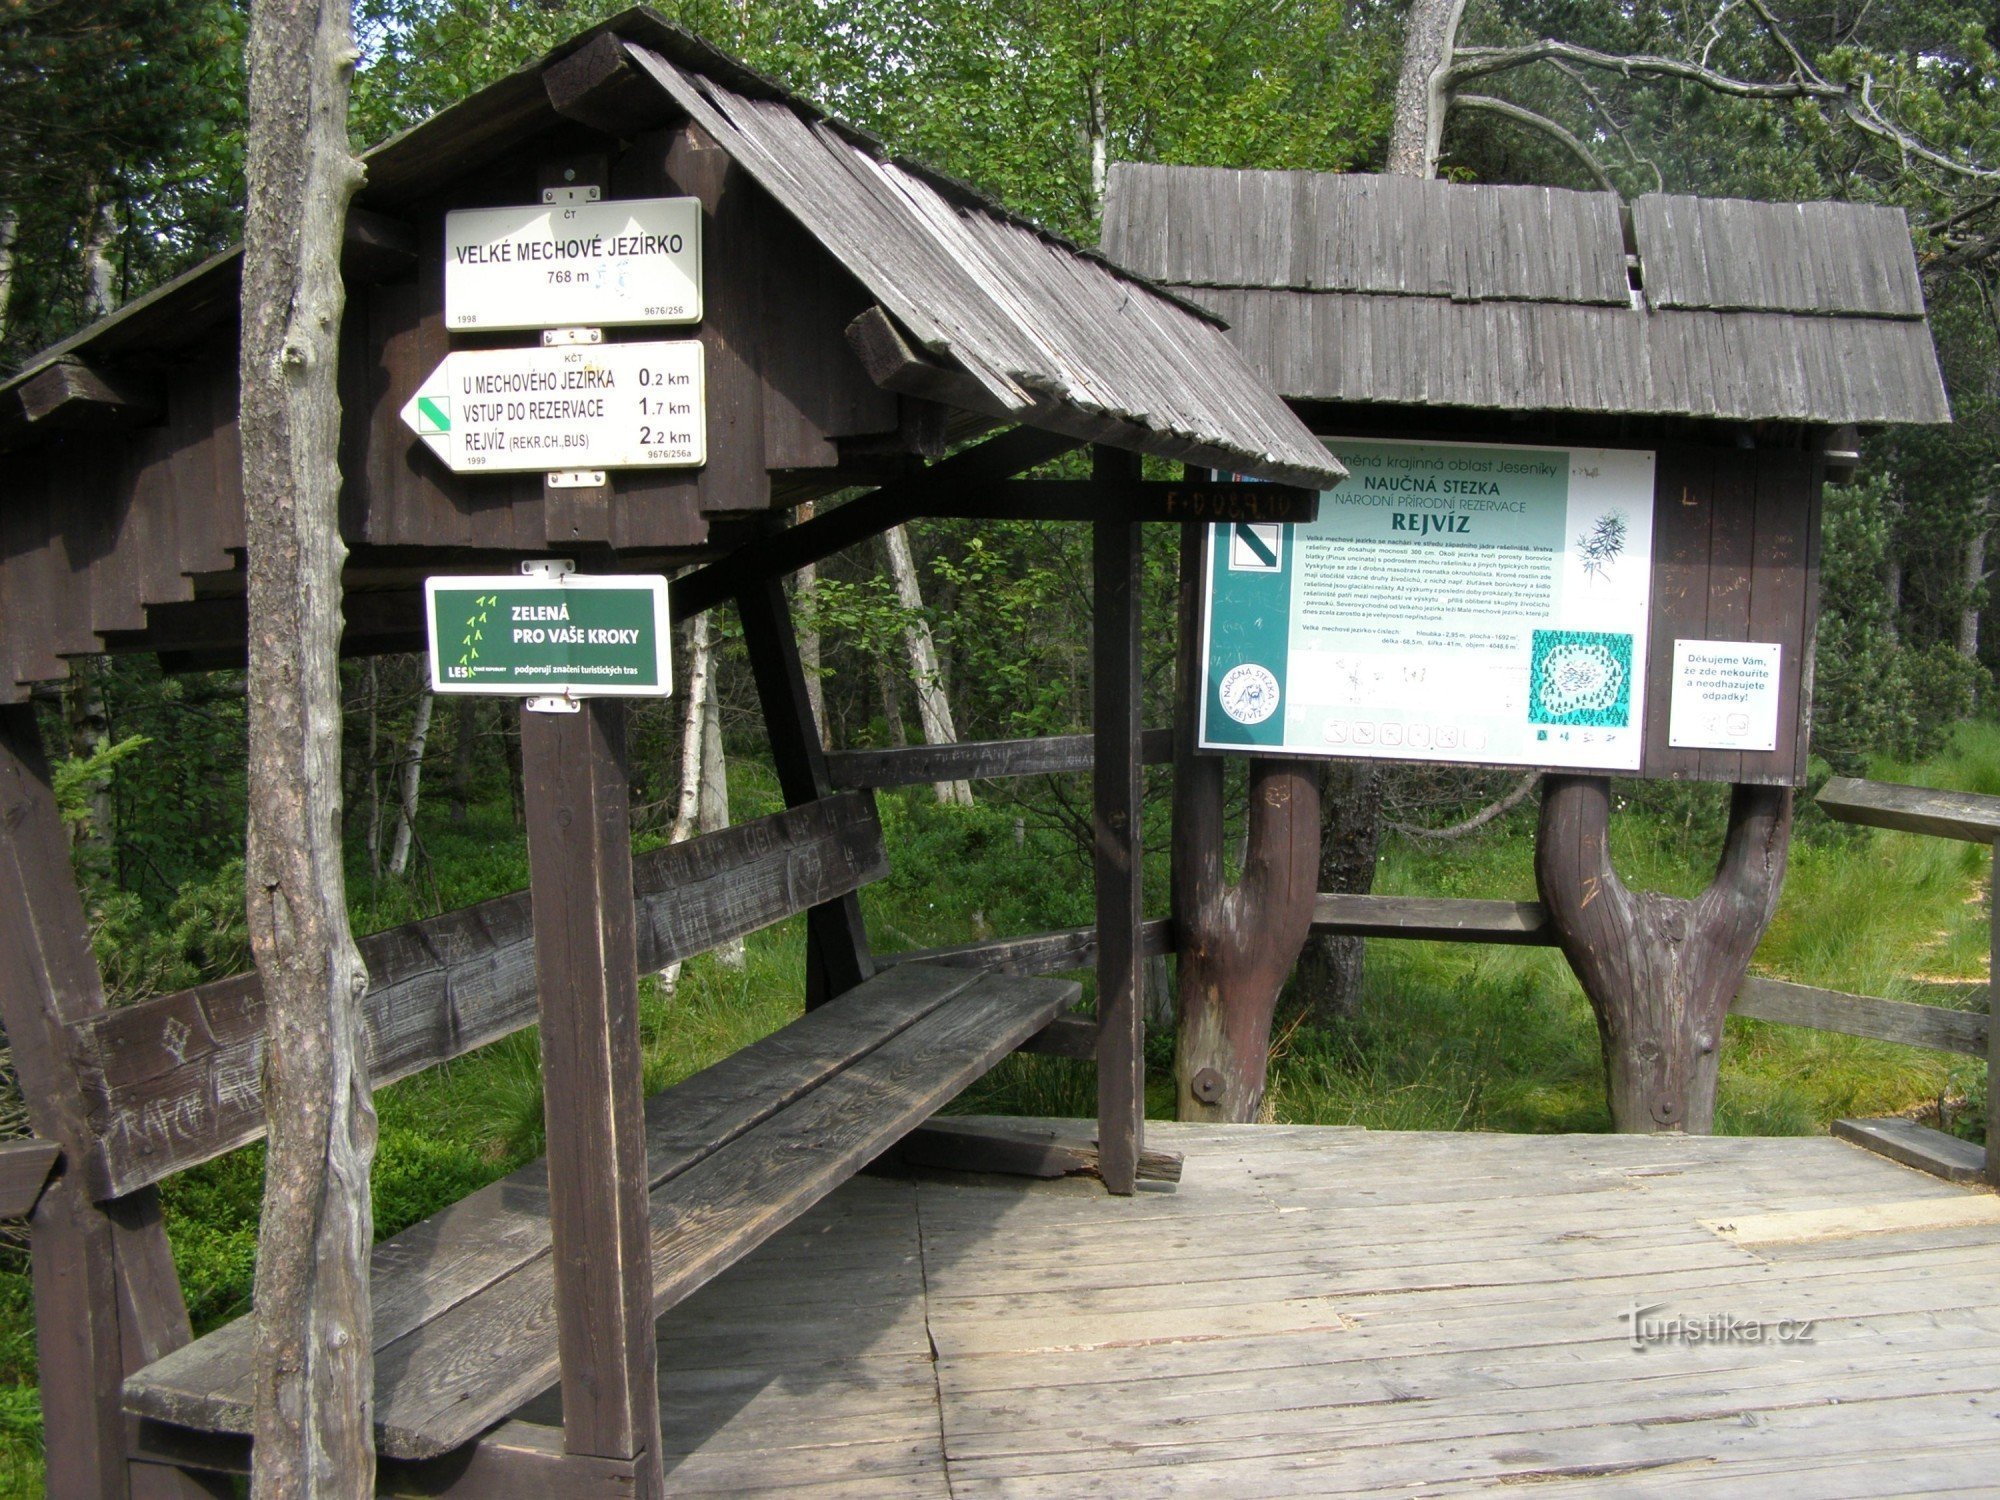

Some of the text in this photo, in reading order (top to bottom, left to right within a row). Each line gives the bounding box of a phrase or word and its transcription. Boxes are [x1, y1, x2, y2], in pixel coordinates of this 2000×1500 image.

[456, 232, 683, 264] VELKÉ MECHOVÉ JEZÍRKO
[548, 271, 589, 283] 768 m
[644, 306, 683, 315] 9676/256
[457, 315, 477, 323] 1998
[564, 353, 582, 363] KČT
[463, 364, 615, 394] U MECHOVÉHO JEZÍRKA
[638, 368, 690, 387] 0.2 km
[463, 399, 604, 422] VSTUP DO REZERVACE
[639, 397, 690, 416] 1.7 km
[465, 428, 505, 450] REJVÍZ
[640, 426, 691, 444] 2.2 km
[467, 456, 486, 464] 1999
[648, 449, 692, 458] 9676/256a
[1387, 456, 1444, 471] krajinná
[1449, 459, 1492, 472] oblast
[1496, 460, 1557, 477] Jeseníky
[1365, 476, 1500, 496] NAUČNÁ STEZKA
[1335, 493, 1526, 513] NÁRODNÍ PŘÍRODNÍ REZERVACE
[1392, 511, 1470, 536] REJVÍZ
[1305, 562, 1336, 570] Vyskytuje
[1387, 566, 1421, 574] masožravá
[1383, 556, 1417, 564] podrostem
[1498, 563, 1529, 571] typických
[512, 603, 570, 621] ZELENÁ
[513, 625, 639, 644] PRO VAŠE KROKY
[1688, 654, 1767, 666] Děkujeme Vám,
[515, 665, 638, 677] podporují značení turistických tras
[1684, 667, 1769, 678] že zde nekouříte
[1696, 680, 1765, 690] neodhazujete
[1702, 692, 1748, 702] odpadky!
